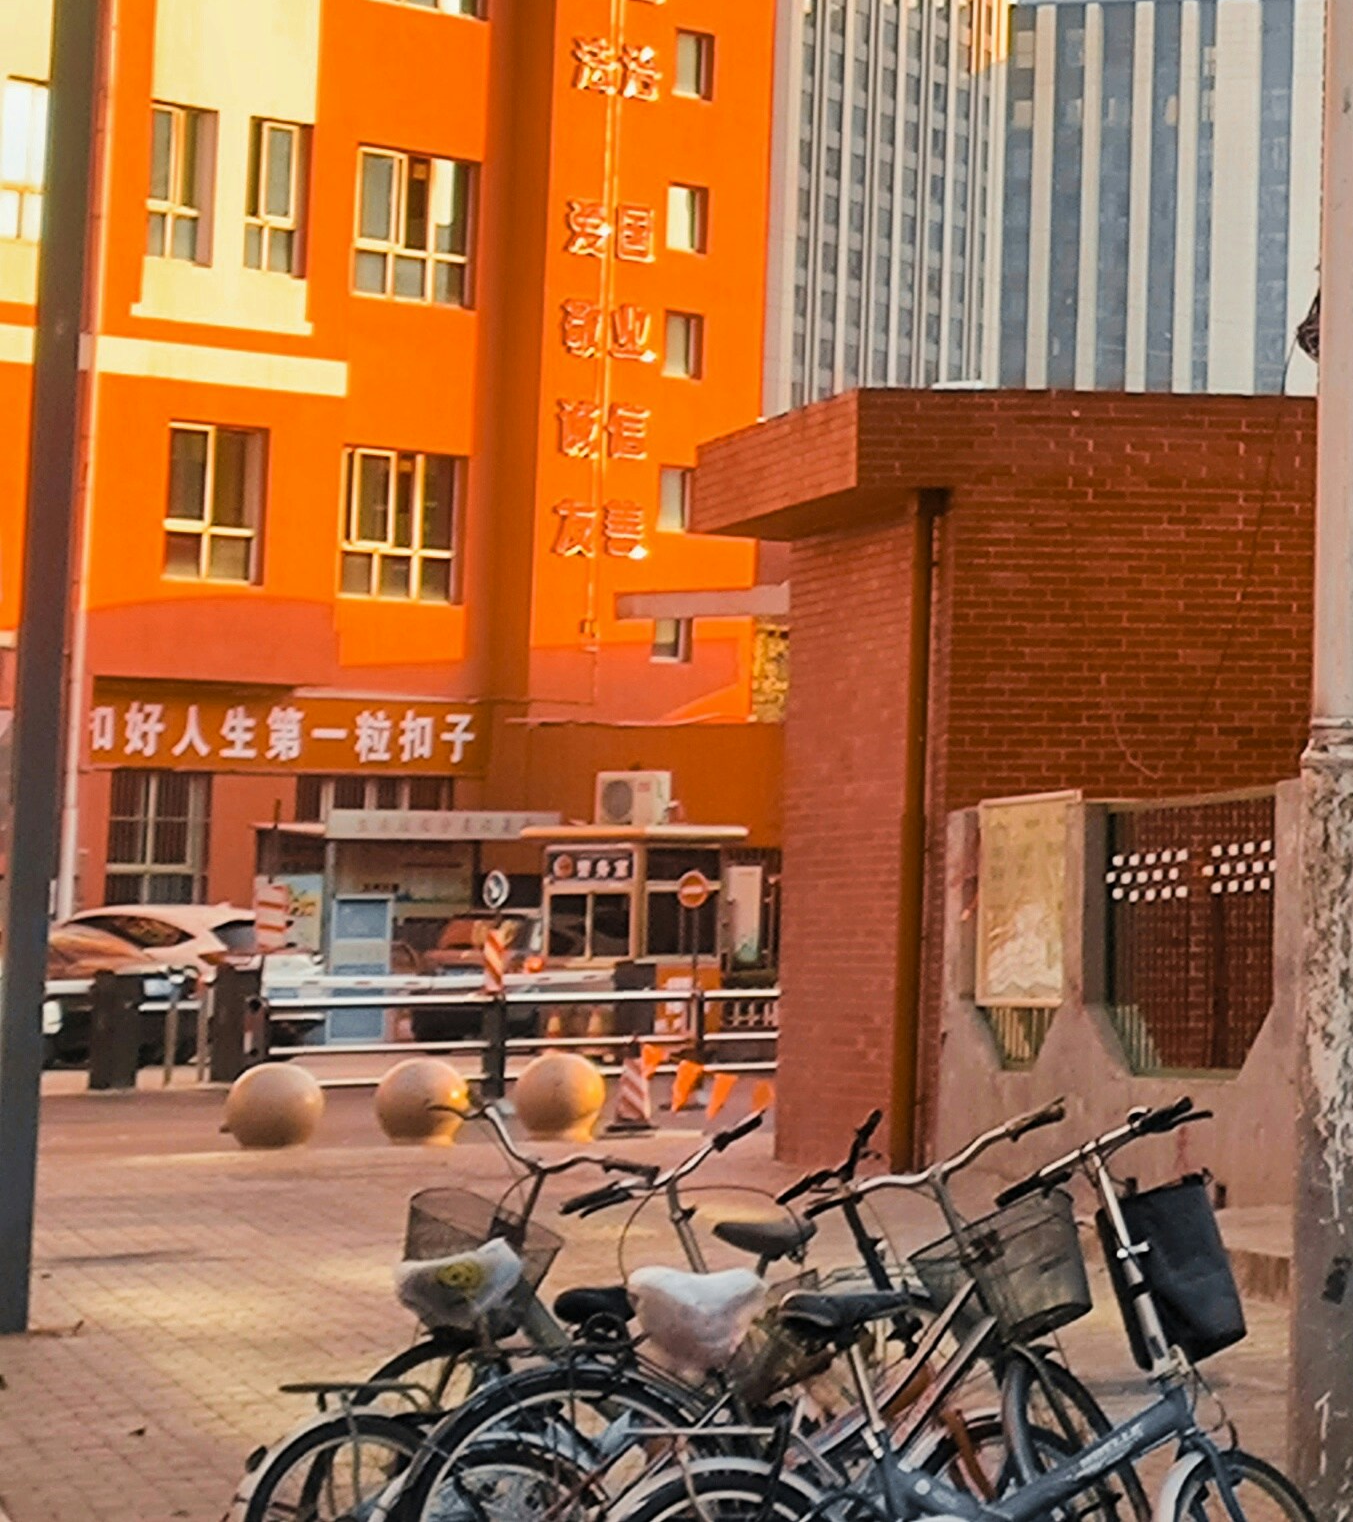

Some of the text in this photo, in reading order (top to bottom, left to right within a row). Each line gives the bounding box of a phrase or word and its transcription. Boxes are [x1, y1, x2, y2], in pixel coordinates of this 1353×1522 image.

[573, 36, 662, 102] 法治
[567, 198, 656, 264] 爱国
[561, 298, 657, 364] 敬业
[557, 398, 651, 460] 诚信
[552, 499, 649, 560] 友善
